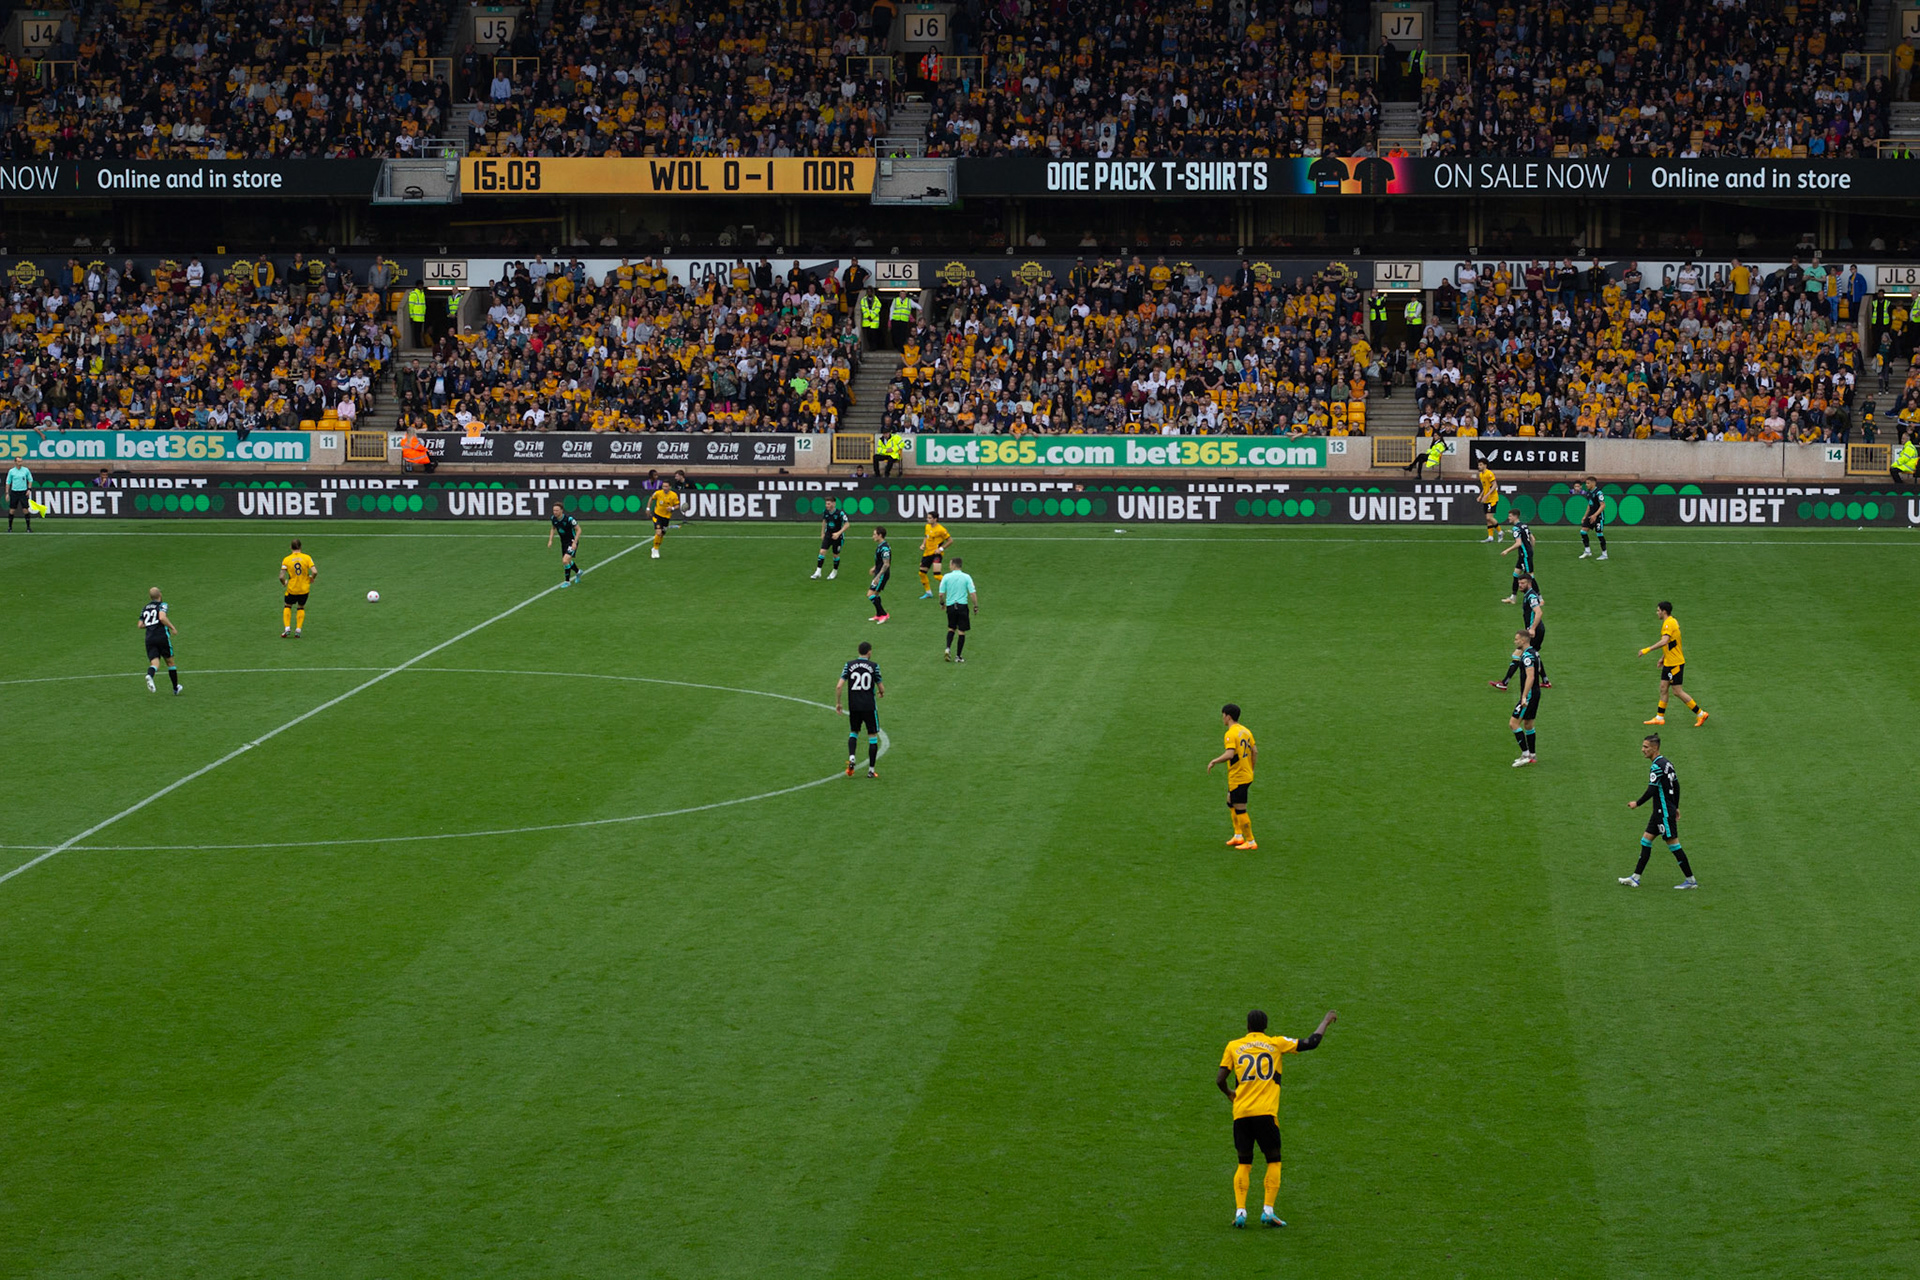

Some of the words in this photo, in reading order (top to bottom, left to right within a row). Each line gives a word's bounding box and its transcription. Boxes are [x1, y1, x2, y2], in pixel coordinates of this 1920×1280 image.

[31, 25, 54, 43] J4
[484, 21, 507, 40] J5
[914, 18, 938, 38] J6
[1391, 16, 1414, 36] J7
[0, 166, 59, 191] NOW
[98, 168, 161, 190] Online
[167, 168, 203, 190] and
[209, 168, 227, 190] in
[232, 170, 282, 190] store
[473, 161, 541, 191] 15:03
[649, 161, 709, 191] WOL
[803, 161, 855, 191] NOR
[1047, 161, 1090, 191] ONE
[1094, 161, 1156, 191] PACK
[1161, 161, 1268, 191] T-SHIRTS
[1434, 163, 1472, 189] ON
[1480, 163, 1539, 189] SALE
[1546, 163, 1610, 189] NOW
[1651, 167, 1720, 190] Online
[1725, 167, 1766, 190] and
[1772, 167, 1791, 190] in
[1797, 169, 1851, 190] store
[432, 263, 460, 278] JL5
[882, 263, 913, 279] JL6
[935, 269, 975, 278] WEDNESFIELD
[1384, 264, 1413, 280] JL7
[1885, 268, 1917, 285] JL8
[117, 433, 304, 459] bet365.com
[323, 437, 334, 448] 11
[797, 438, 811, 450] 12
[903, 439, 912, 451] 3
[925, 437, 1115, 464] bet365.com
[1126, 439, 1317, 465] bet365.com
[1330, 441, 1344, 453] 13
[1502, 450, 1580, 463] CASTORE
[1827, 449, 1842, 461] 14
[237, 491, 337, 516] UNIBET
[449, 491, 549, 516] UNIBET
[680, 493, 782, 517] UNIBET
[897, 493, 1000, 518] UNIBET
[1117, 495, 1221, 520] UNIBET
[1350, 496, 1454, 521] UNIBET
[1679, 498, 1785, 523] UNIBET
[294, 562, 302, 576] 8
[143, 609, 159, 627] 22
[850, 671, 872, 691] 20
[1237, 1052, 1274, 1082] 20
